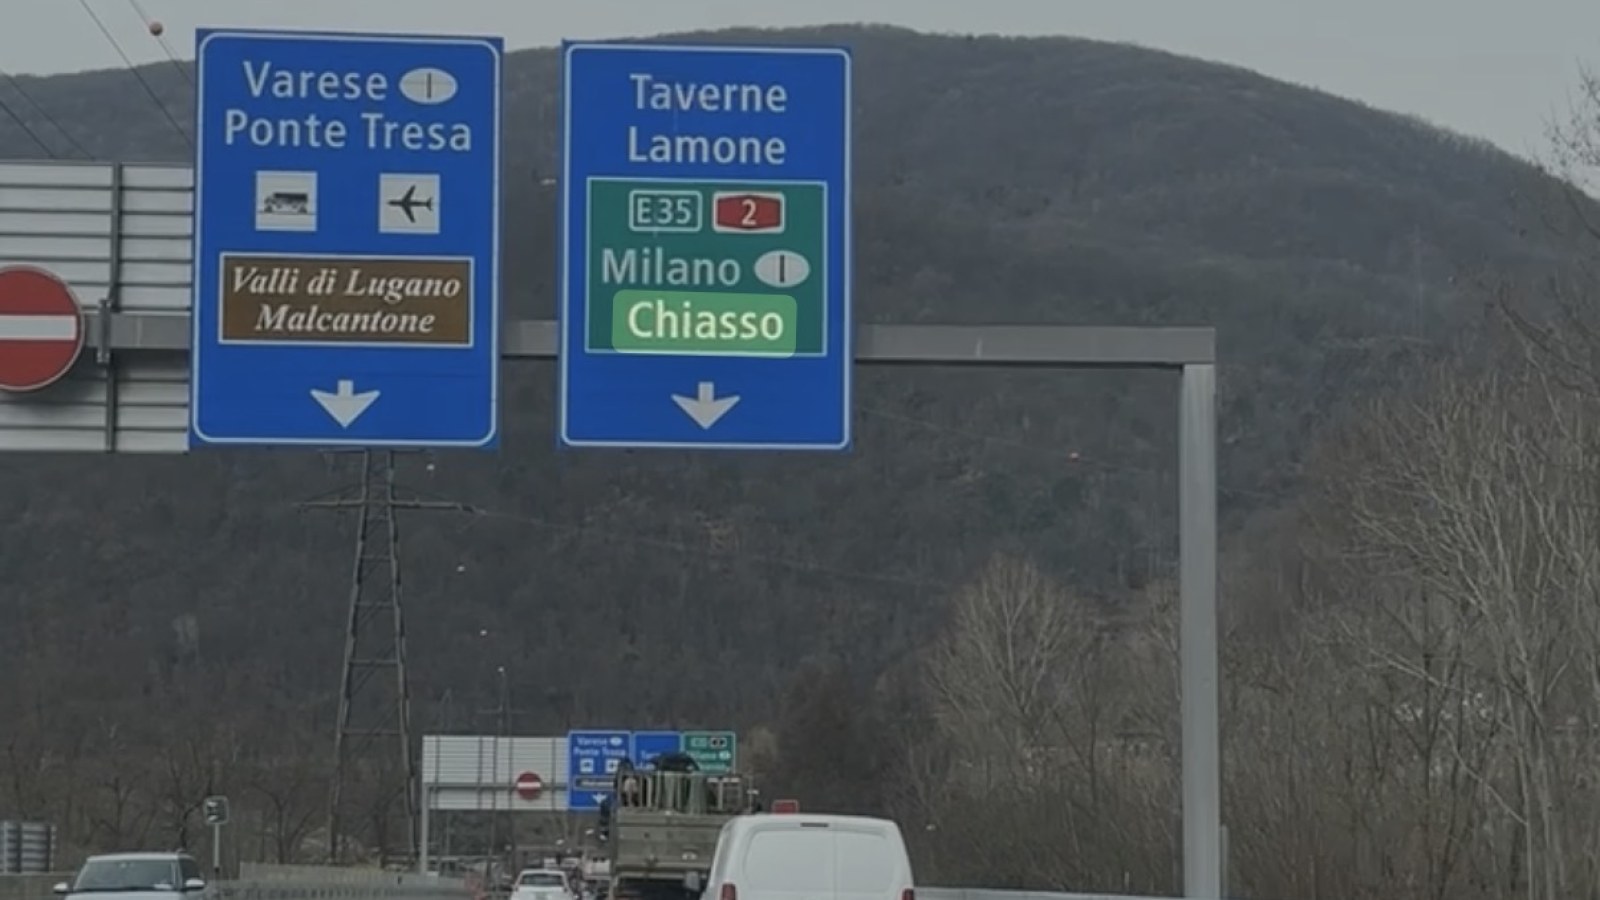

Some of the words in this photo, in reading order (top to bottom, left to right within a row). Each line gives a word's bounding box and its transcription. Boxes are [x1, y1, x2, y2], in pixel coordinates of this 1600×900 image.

[243, 60, 388, 100] Varese
[629, 73, 788, 113] Taverne
[225, 108, 347, 148] Ponte
[361, 111, 473, 152] Tresa
[628, 125, 787, 166] Lamone
[636, 197, 692, 225] E35
[741, 199, 757, 226] 2
[231, 266, 300, 294] Valli
[307, 268, 338, 295] di
[344, 269, 462, 302] Lugano
[601, 247, 741, 286] Milano
[254, 303, 436, 334] Malcantone
[628, 299, 784, 341] Chiasso
